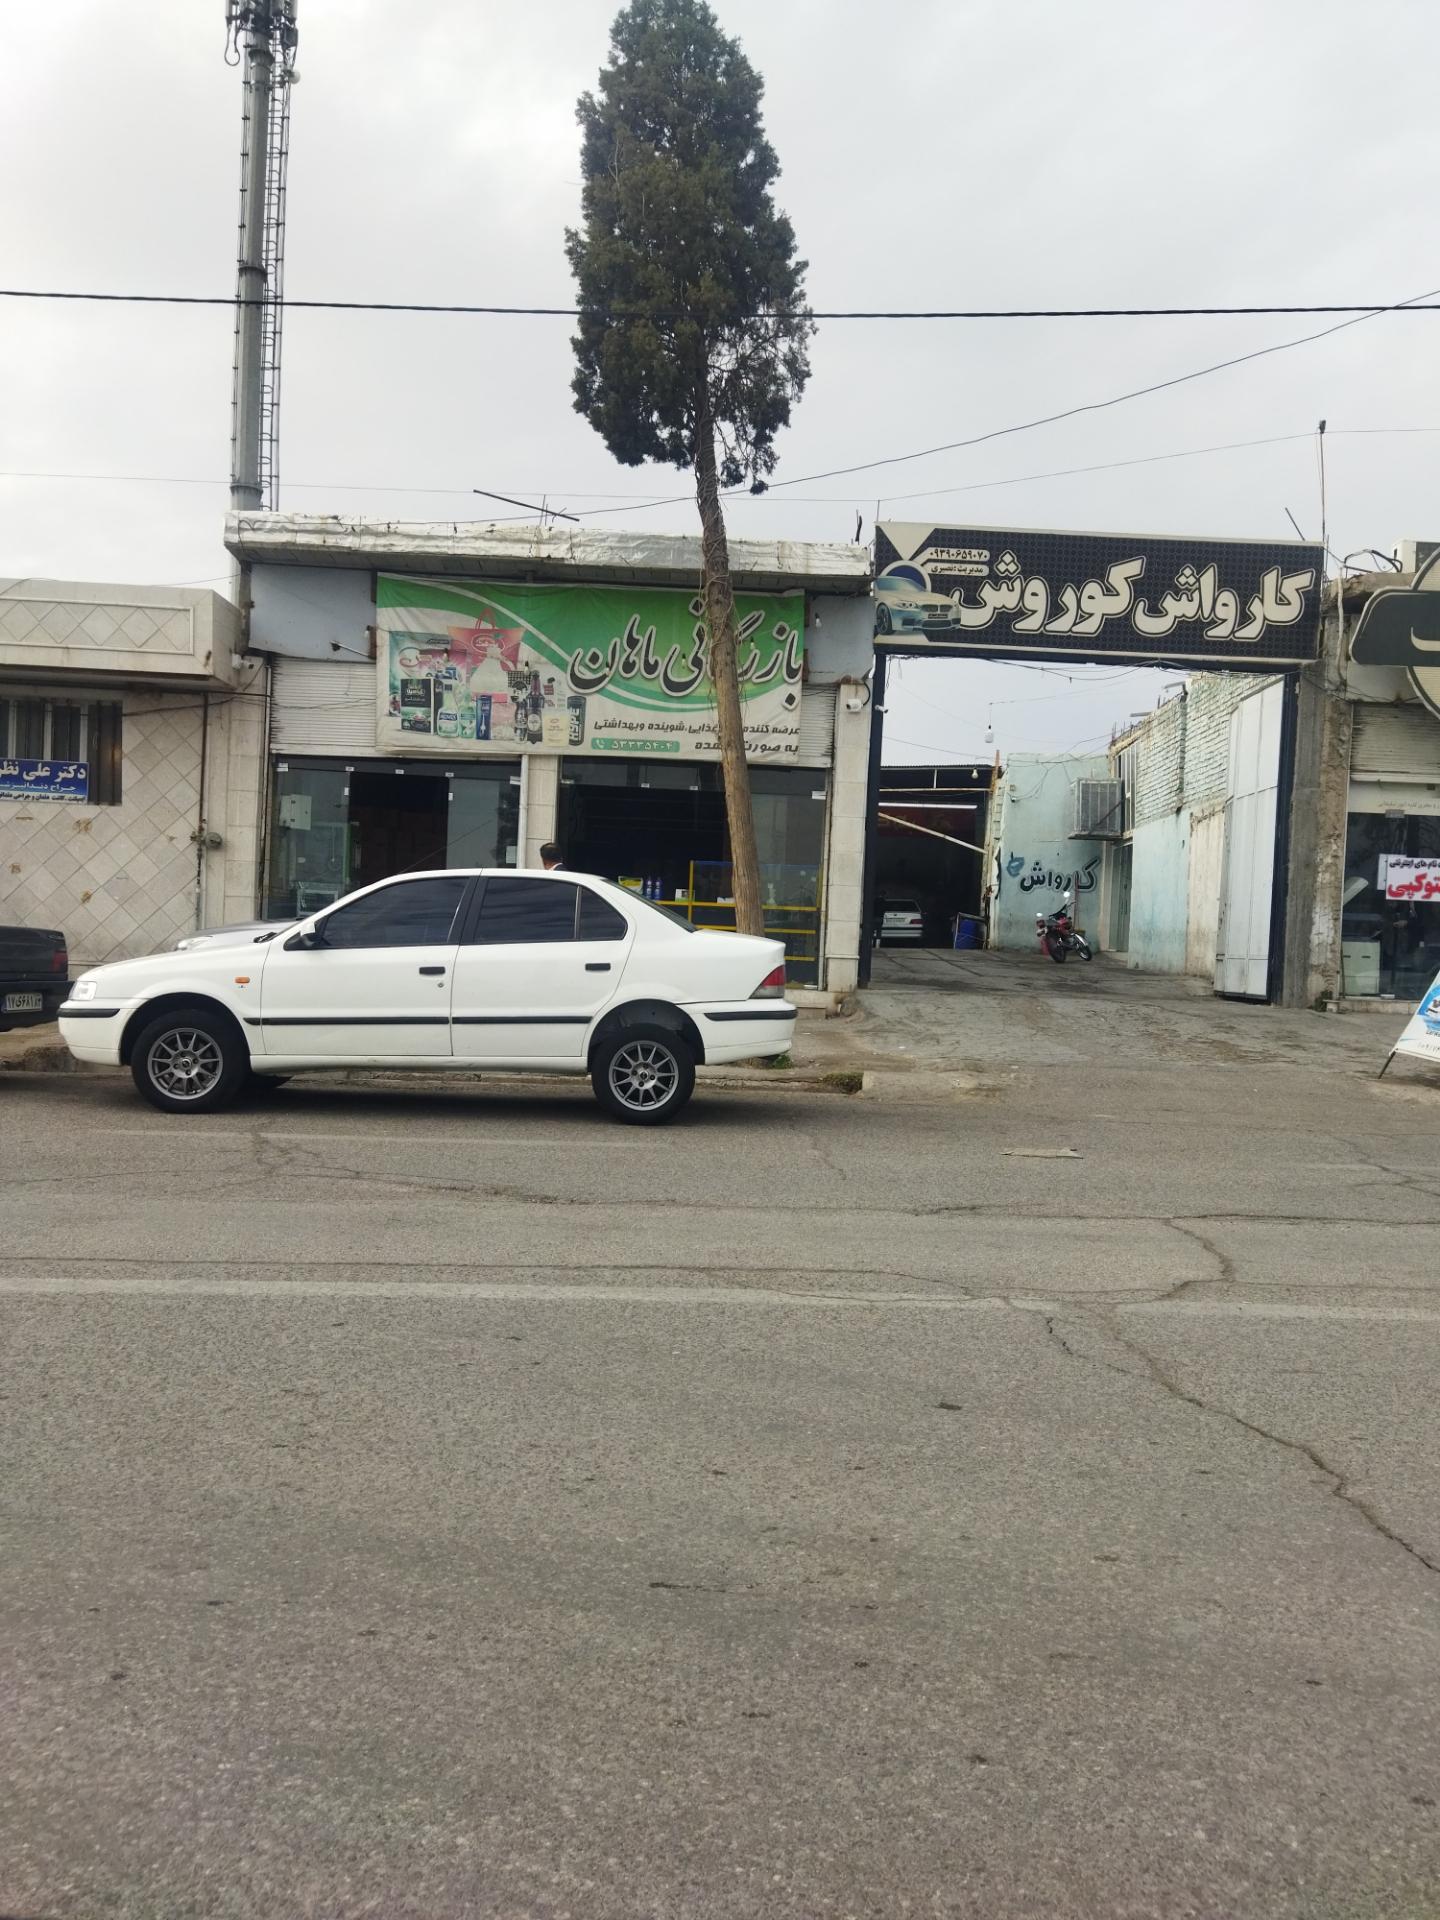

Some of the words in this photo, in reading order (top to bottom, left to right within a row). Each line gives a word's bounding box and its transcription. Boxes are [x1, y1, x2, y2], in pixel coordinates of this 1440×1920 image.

[951, 551, 1146, 637] کوروش
[1133, 563, 1315, 641] کارواش
[568, 614, 662, 694] ماهان
[660, 598, 803, 709] بازرگنی
[648, 721, 685, 733] شوینده
[743, 724, 770, 734] کننده
[771, 725, 800, 735] عرضه
[784, 744, 799, 755] به
[22, 762, 51, 780] علی
[54, 764, 87, 783] دکتر
[50, 784, 77, 793] جراح
[1020, 857, 1099, 893] کارواش
